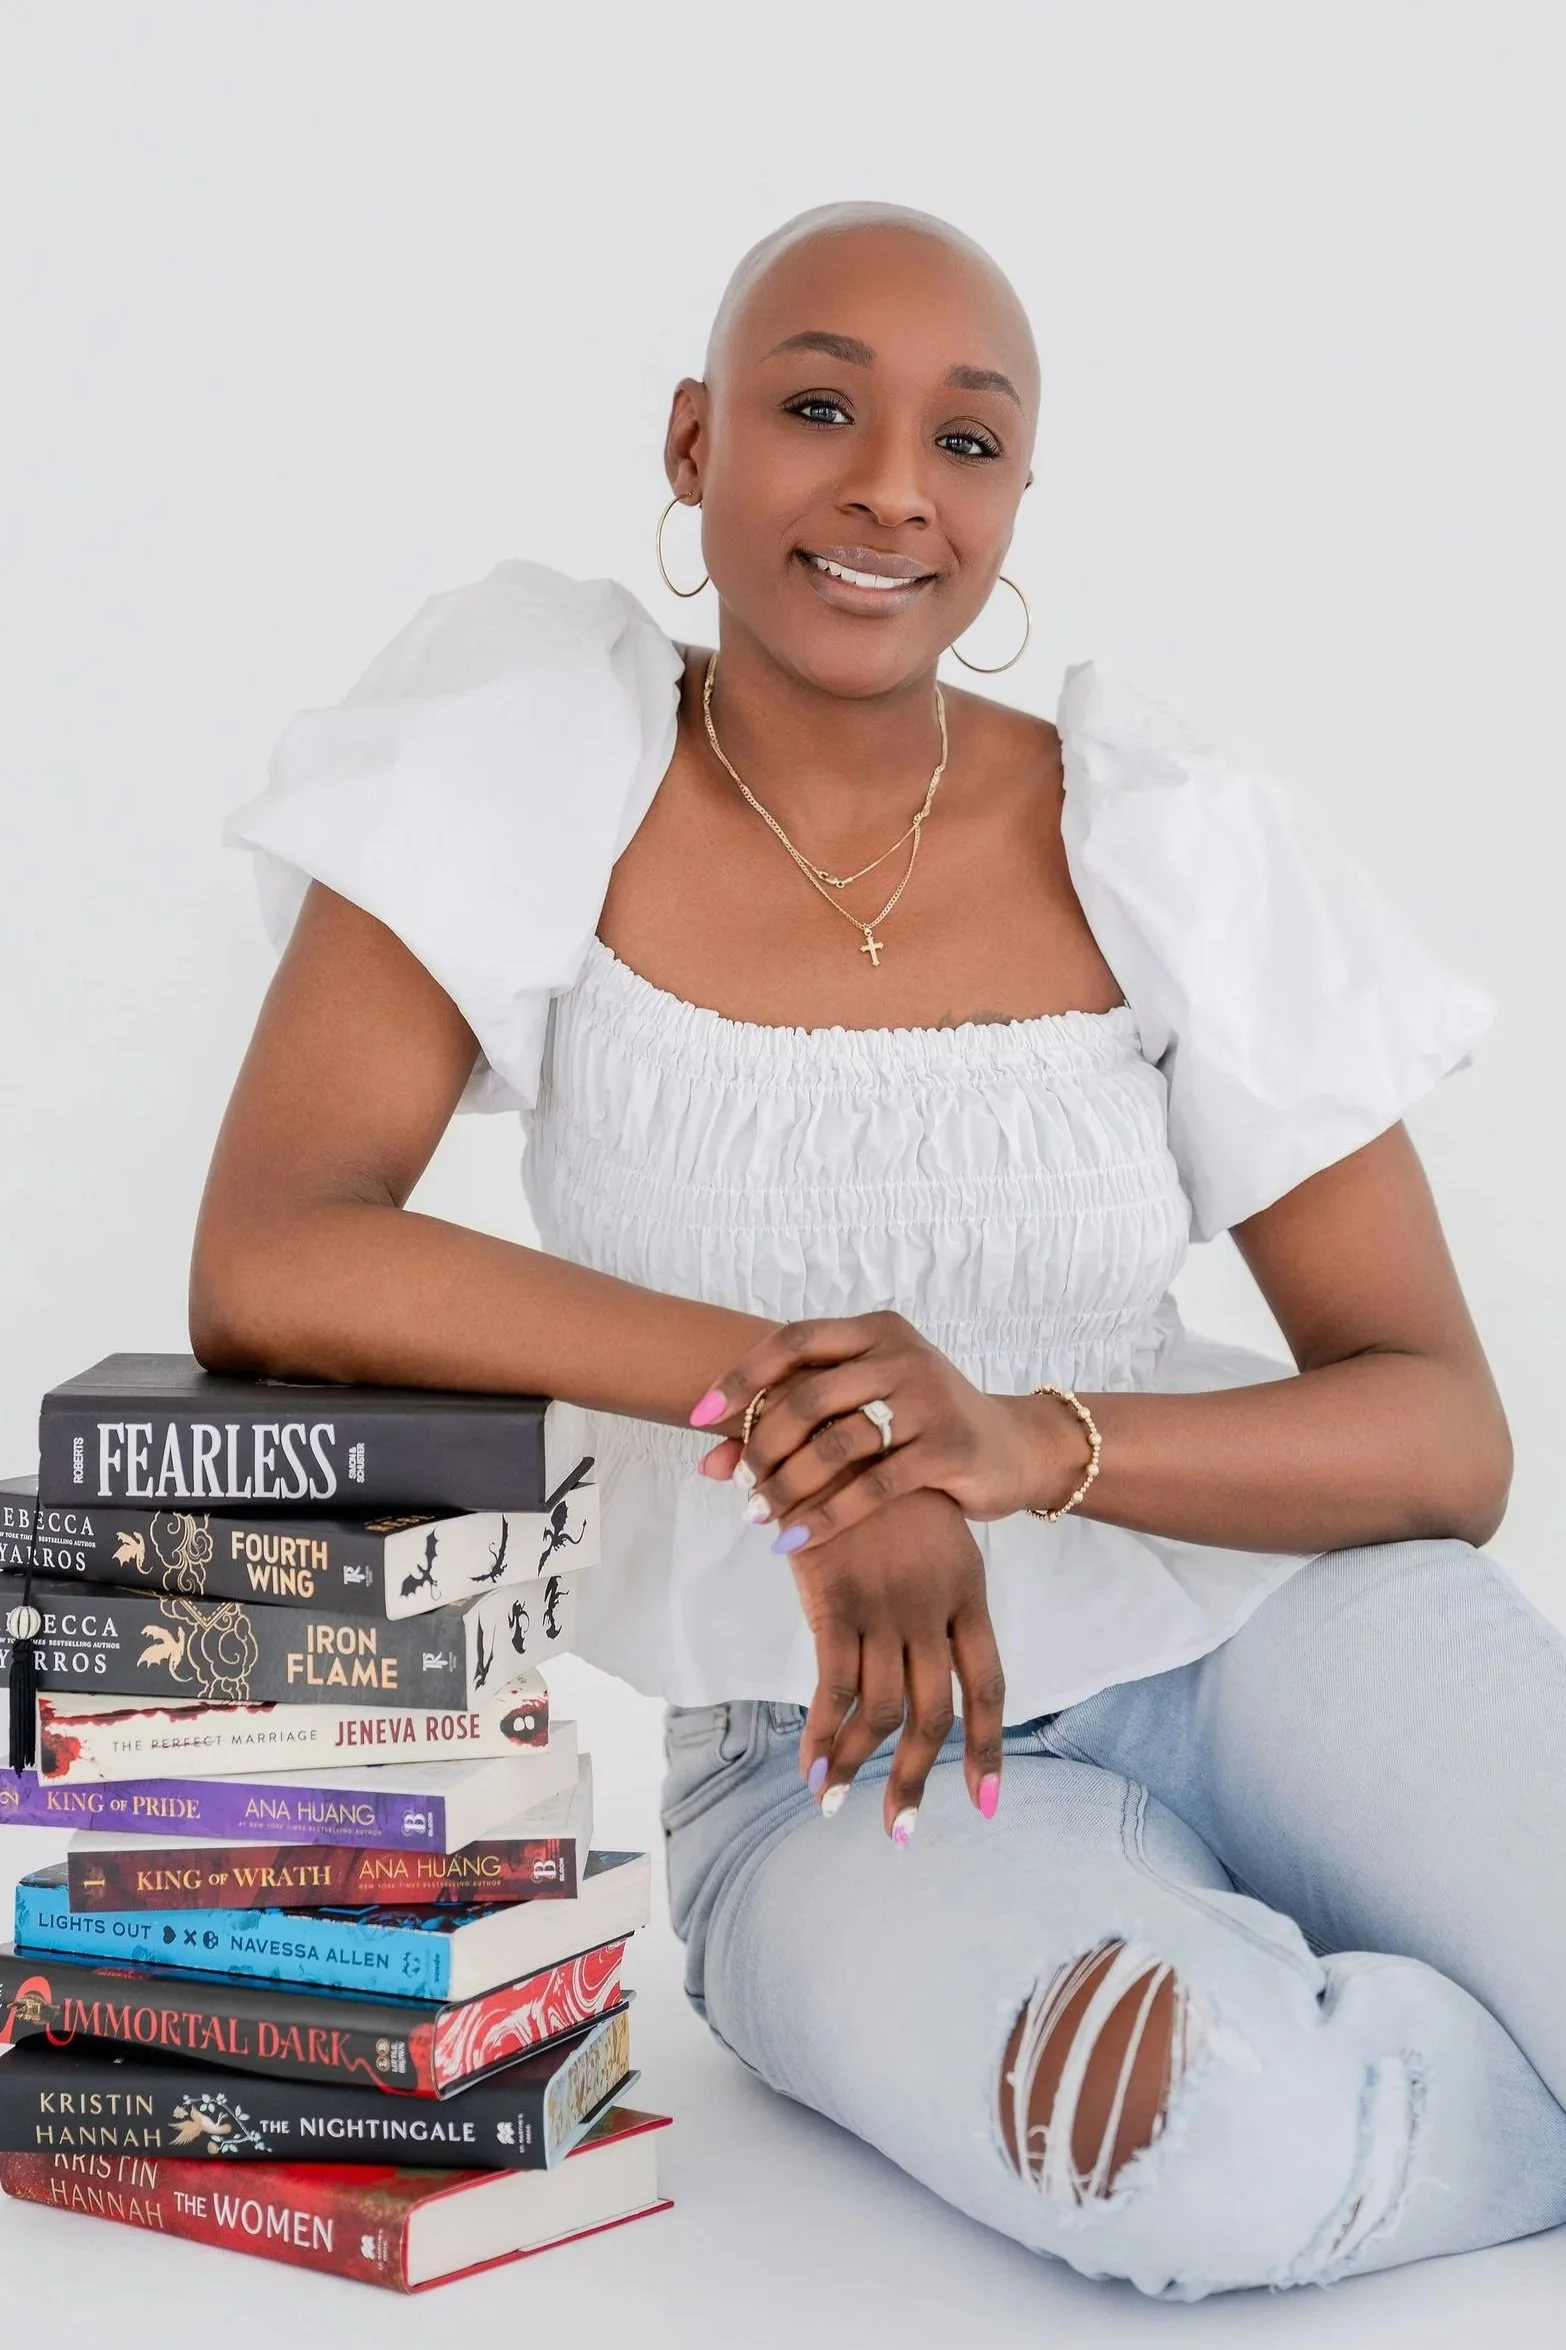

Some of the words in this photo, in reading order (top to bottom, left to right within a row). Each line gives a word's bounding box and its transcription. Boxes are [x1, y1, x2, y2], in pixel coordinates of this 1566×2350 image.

[73, 1437, 84, 1484] ROBERTS
[97, 1422, 337, 1499] FEARLESS
[348, 1454, 356, 1480] SIMON
[356, 1442, 365, 1483] SCHUSTER
[38, 1536, 73, 1545] BESTSELLING
[74, 1540, 96, 1548] AUTHOR
[231, 1530, 328, 1571] FOURTH
[246, 1562, 315, 1599] WING
[49, 1639, 92, 1648] BESTSELLING
[93, 1642, 121, 1650] AUTHOR
[307, 1624, 377, 1655] IRON
[0, 1648, 107, 1674] YRROS
[287, 1653, 398, 1689] FLAME
[112, 1740, 142, 1753] THE
[151, 1735, 223, 1749] PERFECT
[231, 1730, 318, 1745] MARRIAGE
[335, 1717, 416, 1747] JENEVA
[426, 1713, 481, 1741] ROSE
[47, 1791, 104, 1813] KING
[110, 1798, 128, 1812] OF
[132, 1795, 201, 1819] PRIDE
[245, 1798, 290, 1820] ANA
[298, 1801, 375, 1826] HUANG
[136, 1869, 200, 1891] KING
[208, 1873, 228, 1886] OF
[232, 1865, 332, 1887] WRATH
[359, 1858, 408, 1880] ANA
[417, 1855, 501, 1879] HUANG
[38, 1912, 106, 1934] LIGHTS
[112, 1922, 152, 1940] OUT
[231, 1936, 319, 1961] NAVESSA
[325, 1948, 389, 1969] ALLEN
[62, 1997, 249, 2056] IMMORTAL
[257, 2021, 351, 2071] DARK
[40, 2092, 153, 2116] KRISTIN
[35, 2125, 161, 2148] HANNAH
[260, 2119, 290, 2134] THE
[300, 2117, 476, 2143] NIGHTINGALE
[50, 2177, 164, 2228] HANNAH
[173, 2191, 208, 2218] THE
[213, 2192, 334, 2253] WOMEN
